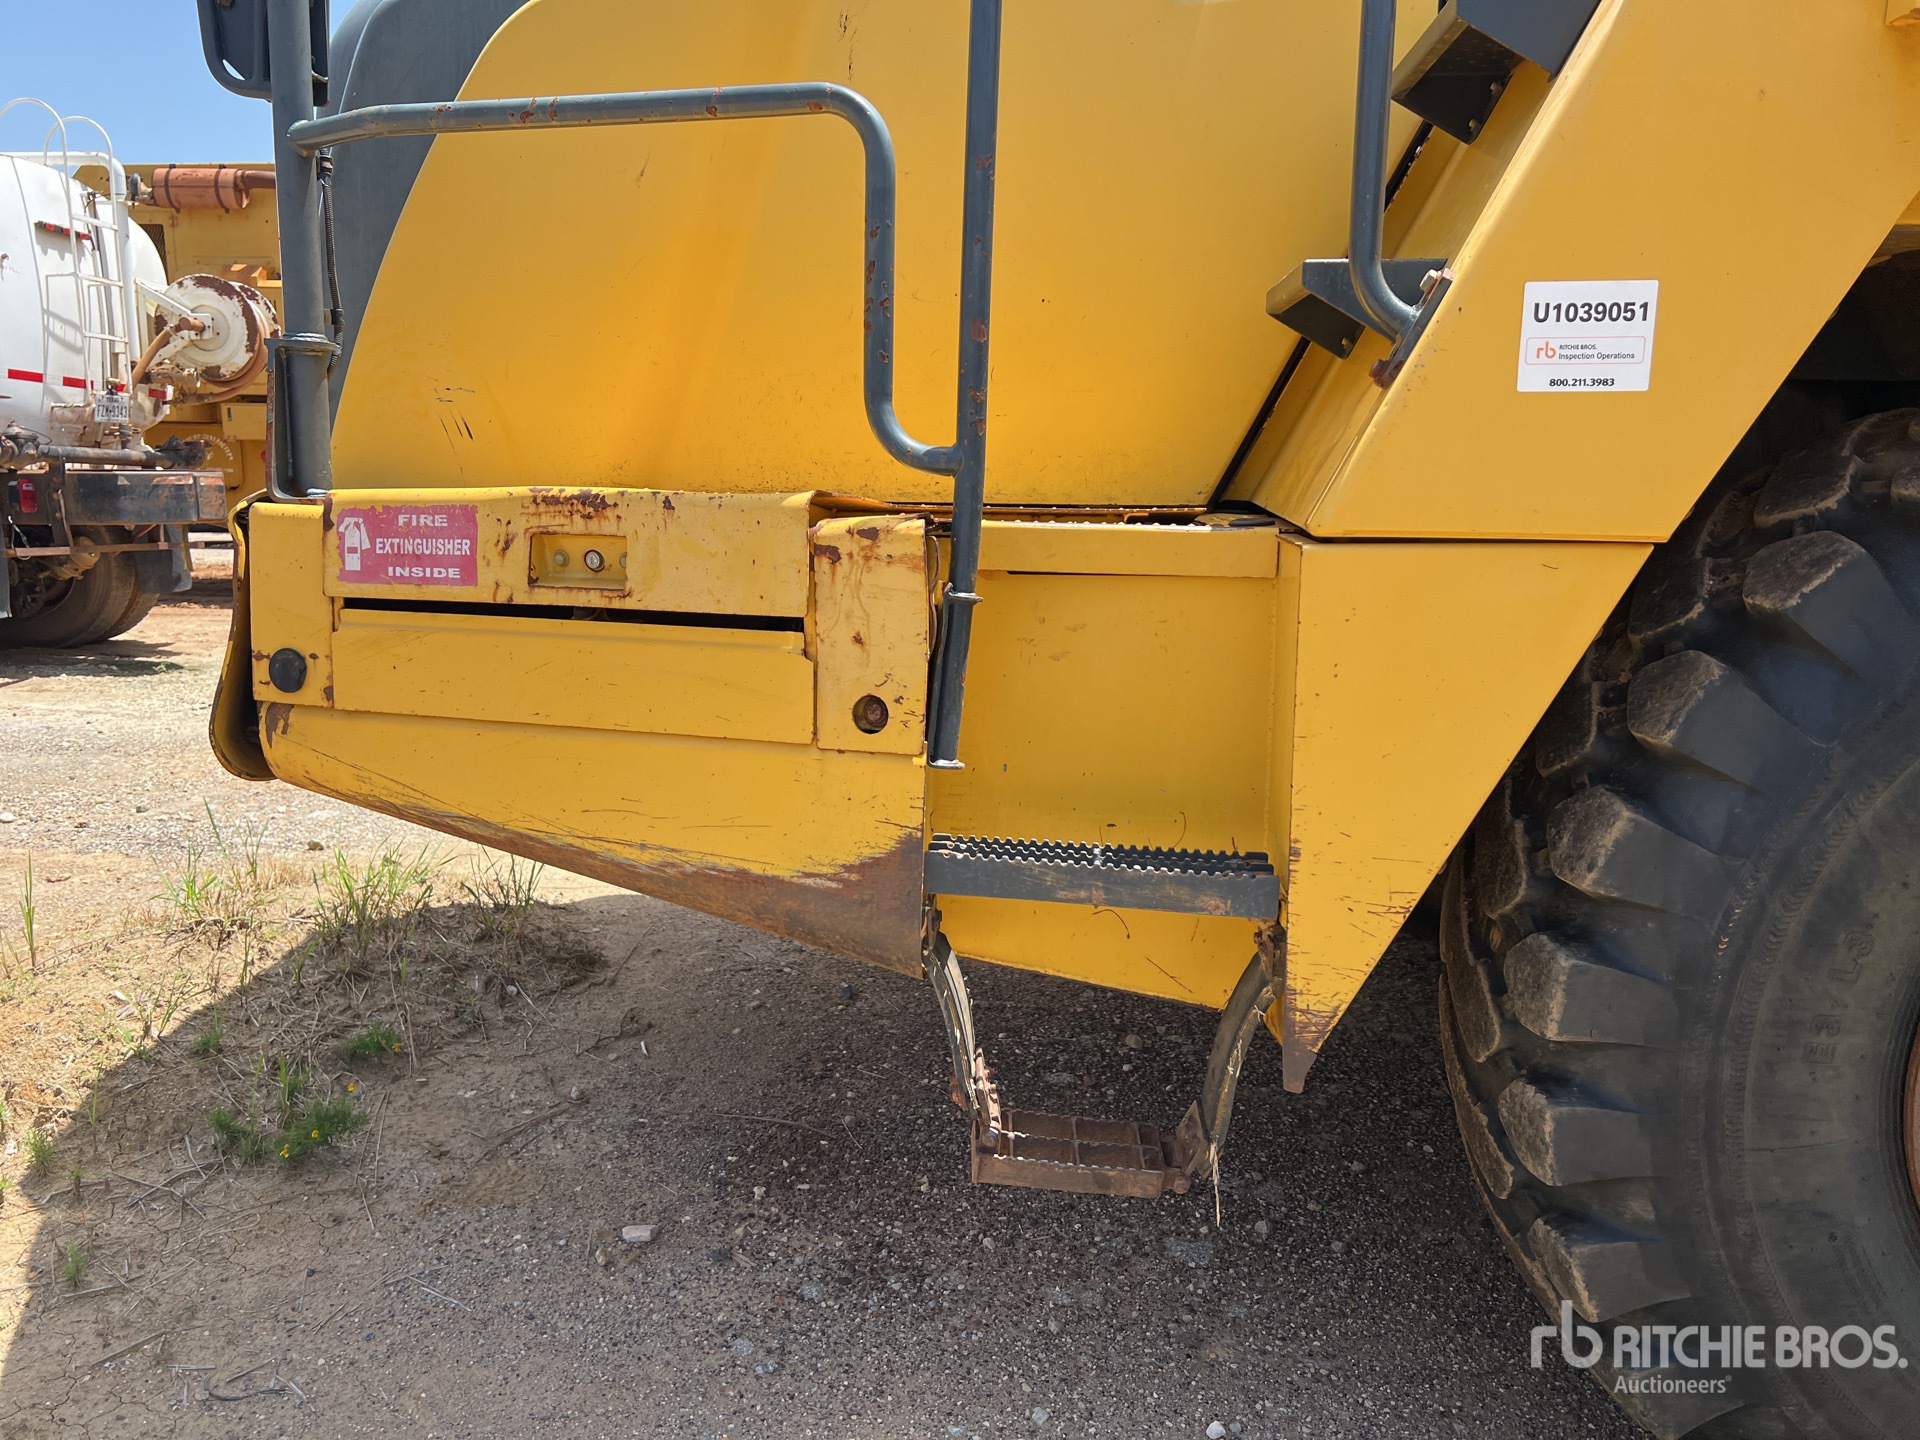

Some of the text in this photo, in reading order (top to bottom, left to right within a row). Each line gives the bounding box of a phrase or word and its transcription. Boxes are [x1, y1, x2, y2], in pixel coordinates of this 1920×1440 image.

[1533, 301, 1649, 323] U1039051
[1536, 341, 1557, 359] rb
[1558, 351, 1635, 361] Inspection Operations
[1549, 378, 1615, 387] 800.211.3983
[398, 514, 448, 527] FIRE
[375, 537, 471, 555] EXTINGUISHER
[388, 566, 461, 579] INSIDE
